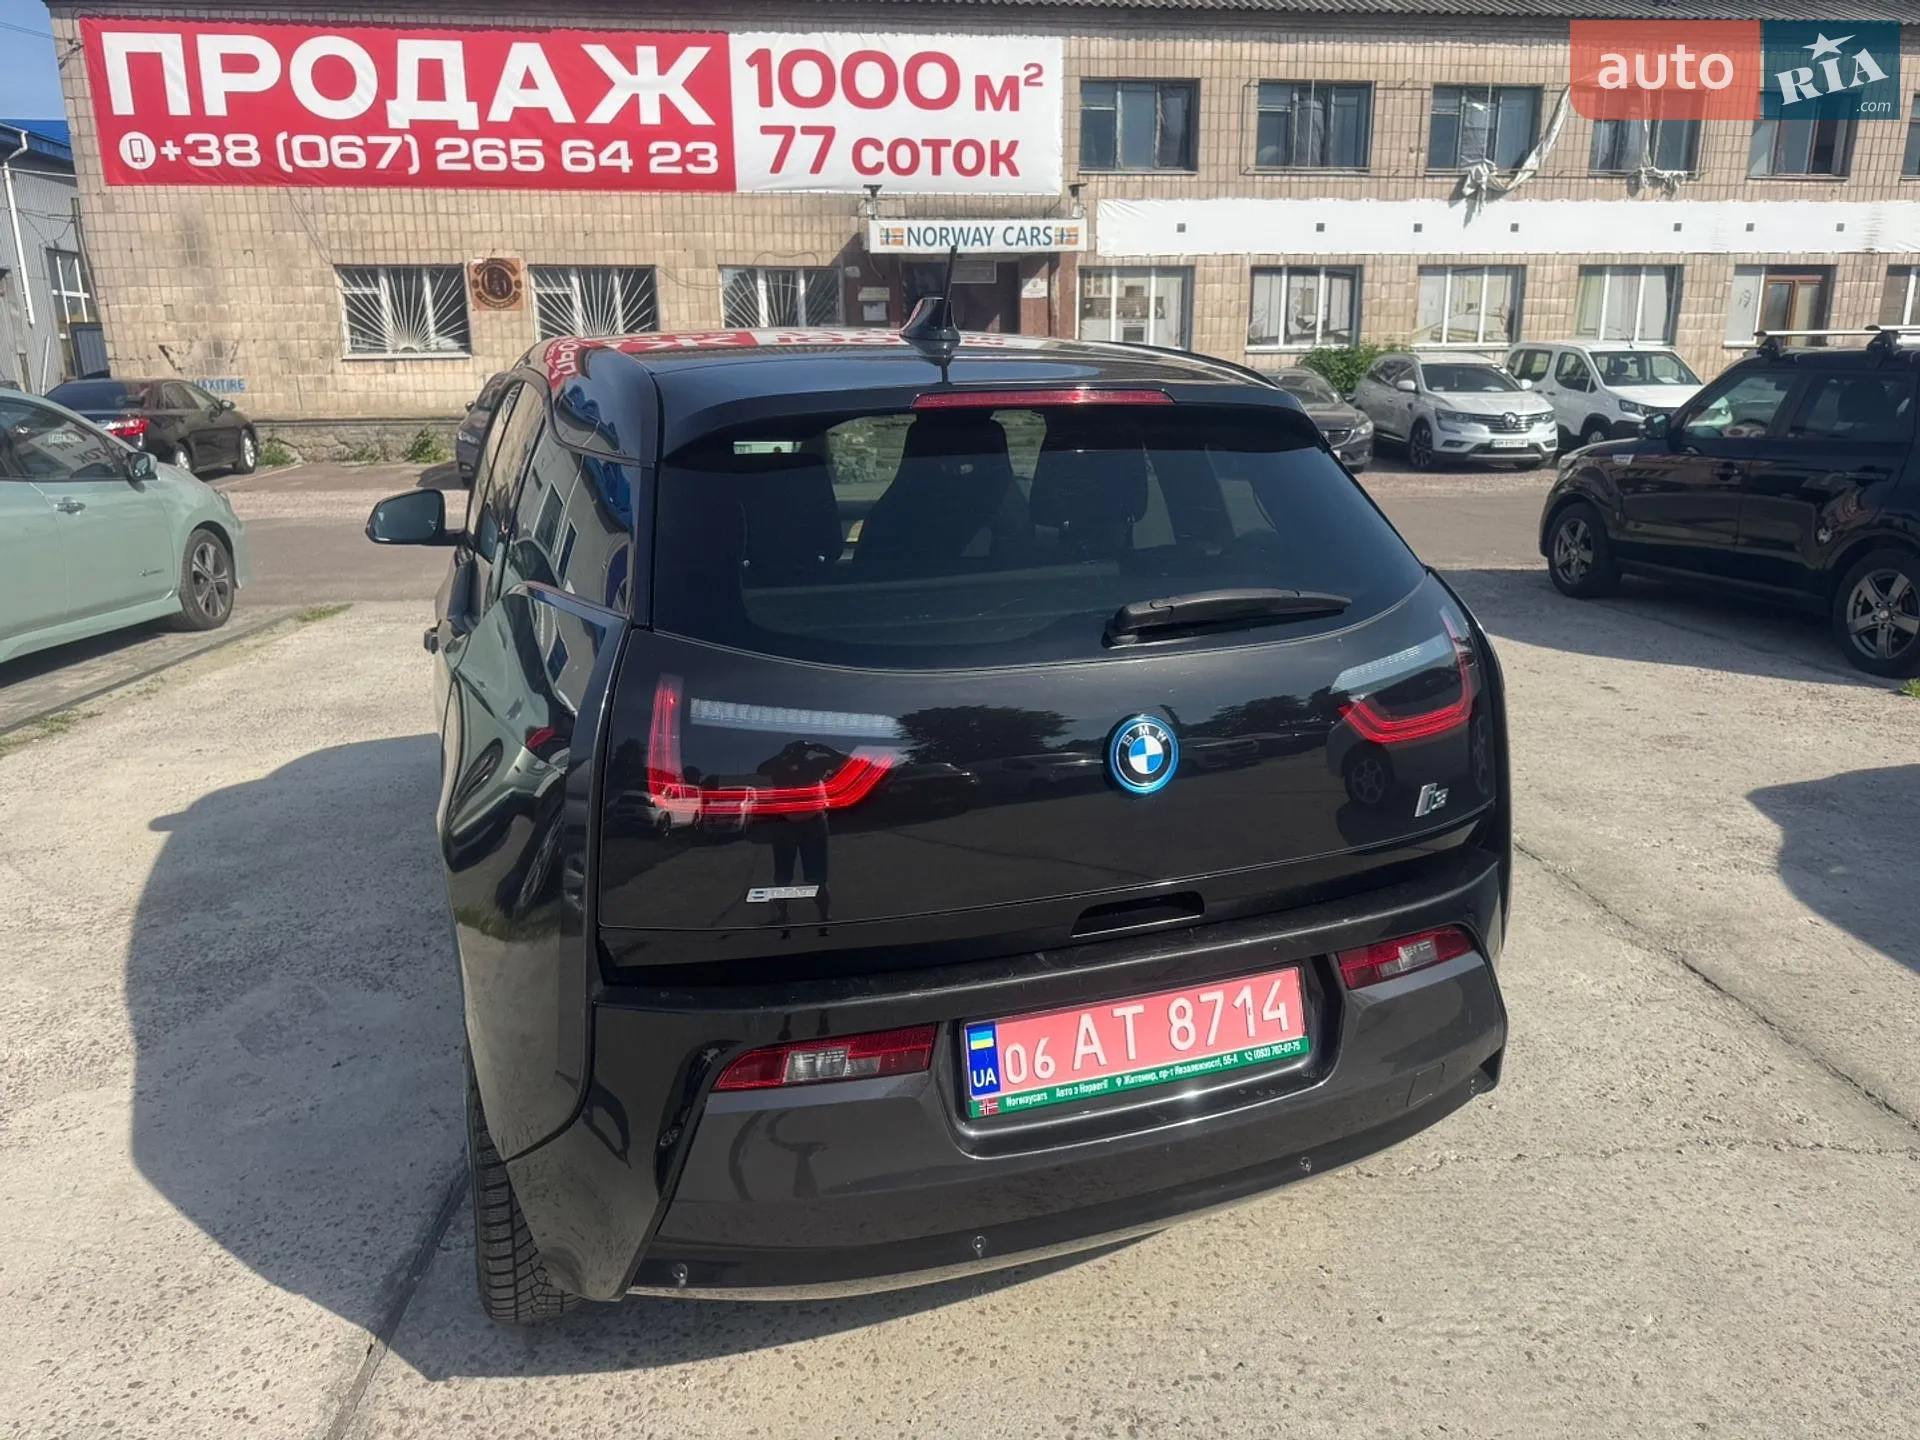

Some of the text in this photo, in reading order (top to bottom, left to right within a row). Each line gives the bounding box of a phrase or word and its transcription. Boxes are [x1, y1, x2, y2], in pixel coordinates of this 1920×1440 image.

[101, 31, 715, 130] ПРОДАЖ
[745, 48, 961, 111] 1000
[159, 130, 719, 176] +38 (067) 265 64 23
[760, 125, 836, 175] 77
[906, 225, 1053, 247] NORWAY CARS
[1122, 725, 1168, 746] BMW
[1005, 979, 1289, 1084] 06 AT 8714
[973, 1067, 997, 1087] UA
[1006, 1092, 1048, 1107] Norwaycars
[1055, 1087, 1073, 1098] Авто
